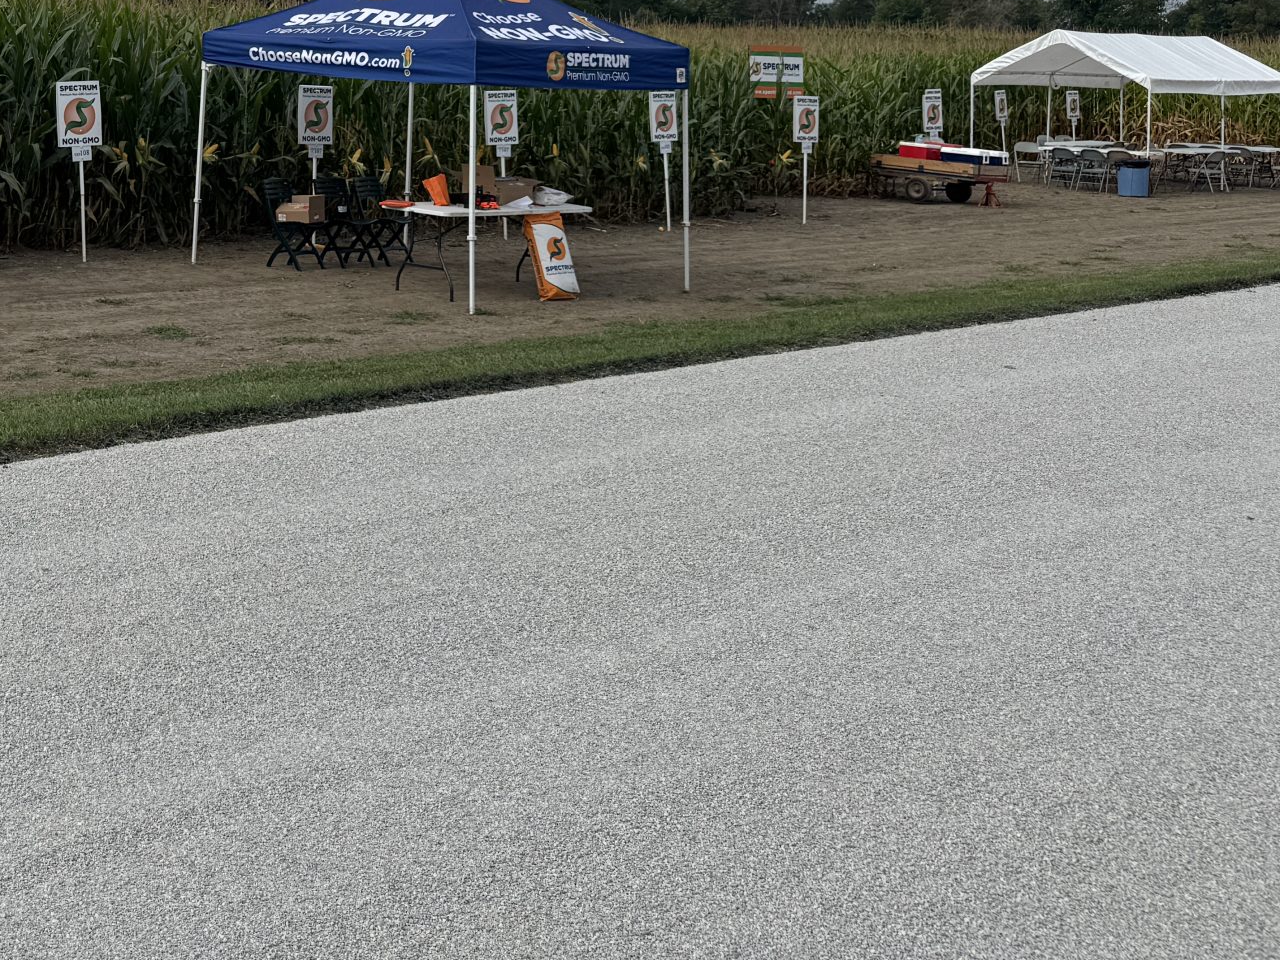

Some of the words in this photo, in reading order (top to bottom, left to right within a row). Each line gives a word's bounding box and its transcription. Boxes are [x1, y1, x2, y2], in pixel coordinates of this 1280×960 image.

[283, 7, 451, 28] SPECTRUM
[472, 11, 542, 24] Choose
[265, 26, 334, 34] Premium
[336, 24, 426, 38] Non-GMO
[478, 24, 609, 43] NON-GMO
[248, 46, 400, 69] ChooseNonGMO.com
[566, 52, 630, 69] SPECTRUM
[566, 70, 596, 81] Premium
[597, 71, 630, 82] Non-GMO
[59, 84, 98, 92] SPECTRUM
[62, 136, 100, 145] NON-GMO
